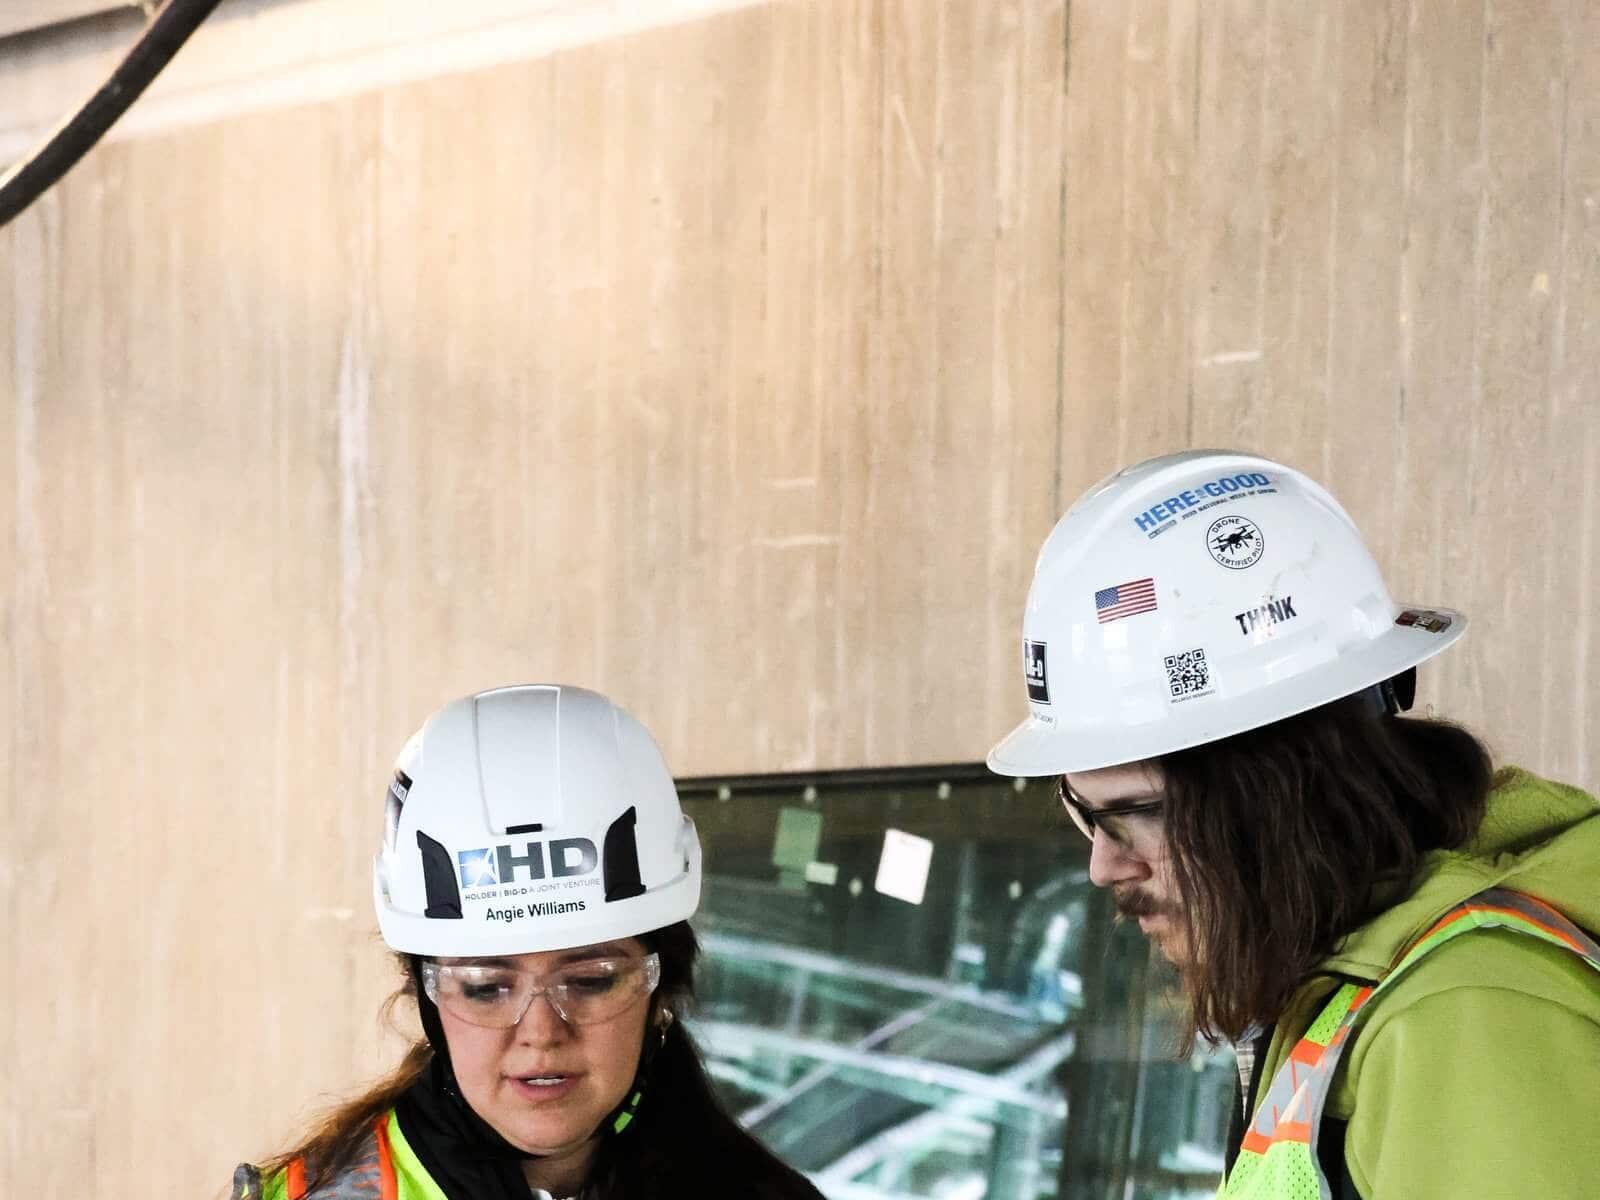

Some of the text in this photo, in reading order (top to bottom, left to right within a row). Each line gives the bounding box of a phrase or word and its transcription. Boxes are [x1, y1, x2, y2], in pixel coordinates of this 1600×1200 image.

[1134, 490, 1200, 532] HERE
[1203, 473, 1270, 497] GOOD
[1211, 518, 1241, 533] DRONE
[495, 837, 598, 884] HD
[464, 890, 497, 901] HOLDER
[504, 888, 527, 897] BIG-D
[537, 883, 560, 893] JOINT
[562, 878, 601, 889] VENTURE
[486, 900, 586, 923] Angie Williams
